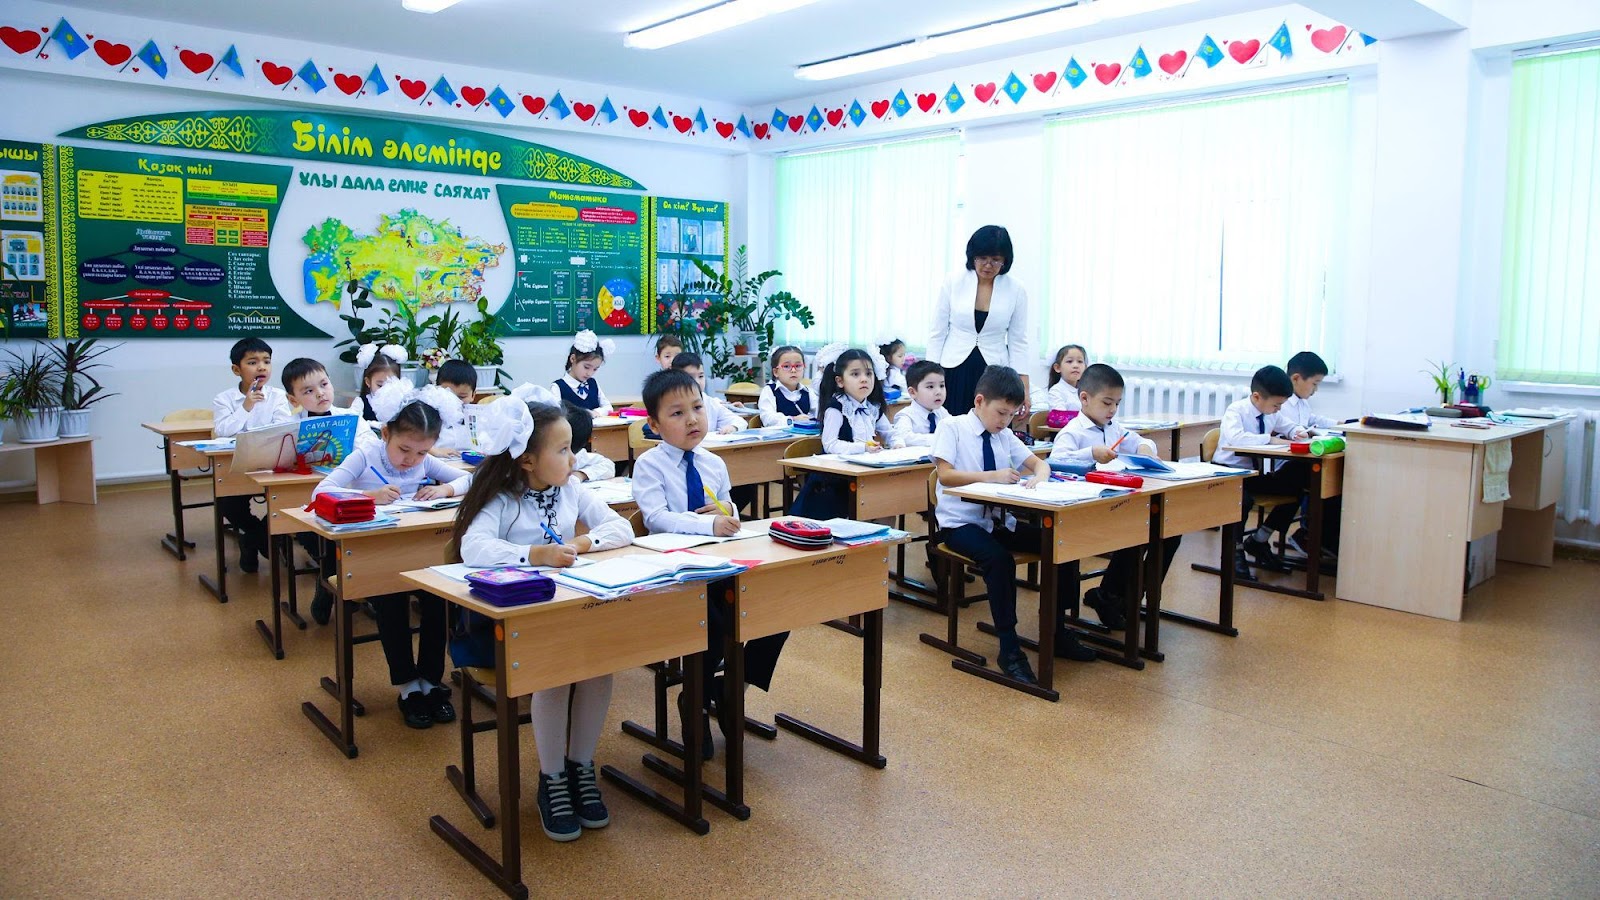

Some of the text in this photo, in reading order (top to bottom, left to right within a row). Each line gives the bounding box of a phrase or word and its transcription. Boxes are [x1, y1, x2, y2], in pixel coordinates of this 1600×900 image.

[291, 119, 502, 176] Білім әлемінде
[137, 158, 213, 176] Қазақ тілі
[340, 175, 385, 191] ДАЛА
[433, 183, 491, 200] САЯХАТ
[549, 190, 608, 204] Математика
[305, 420, 331, 431] САУАТ
